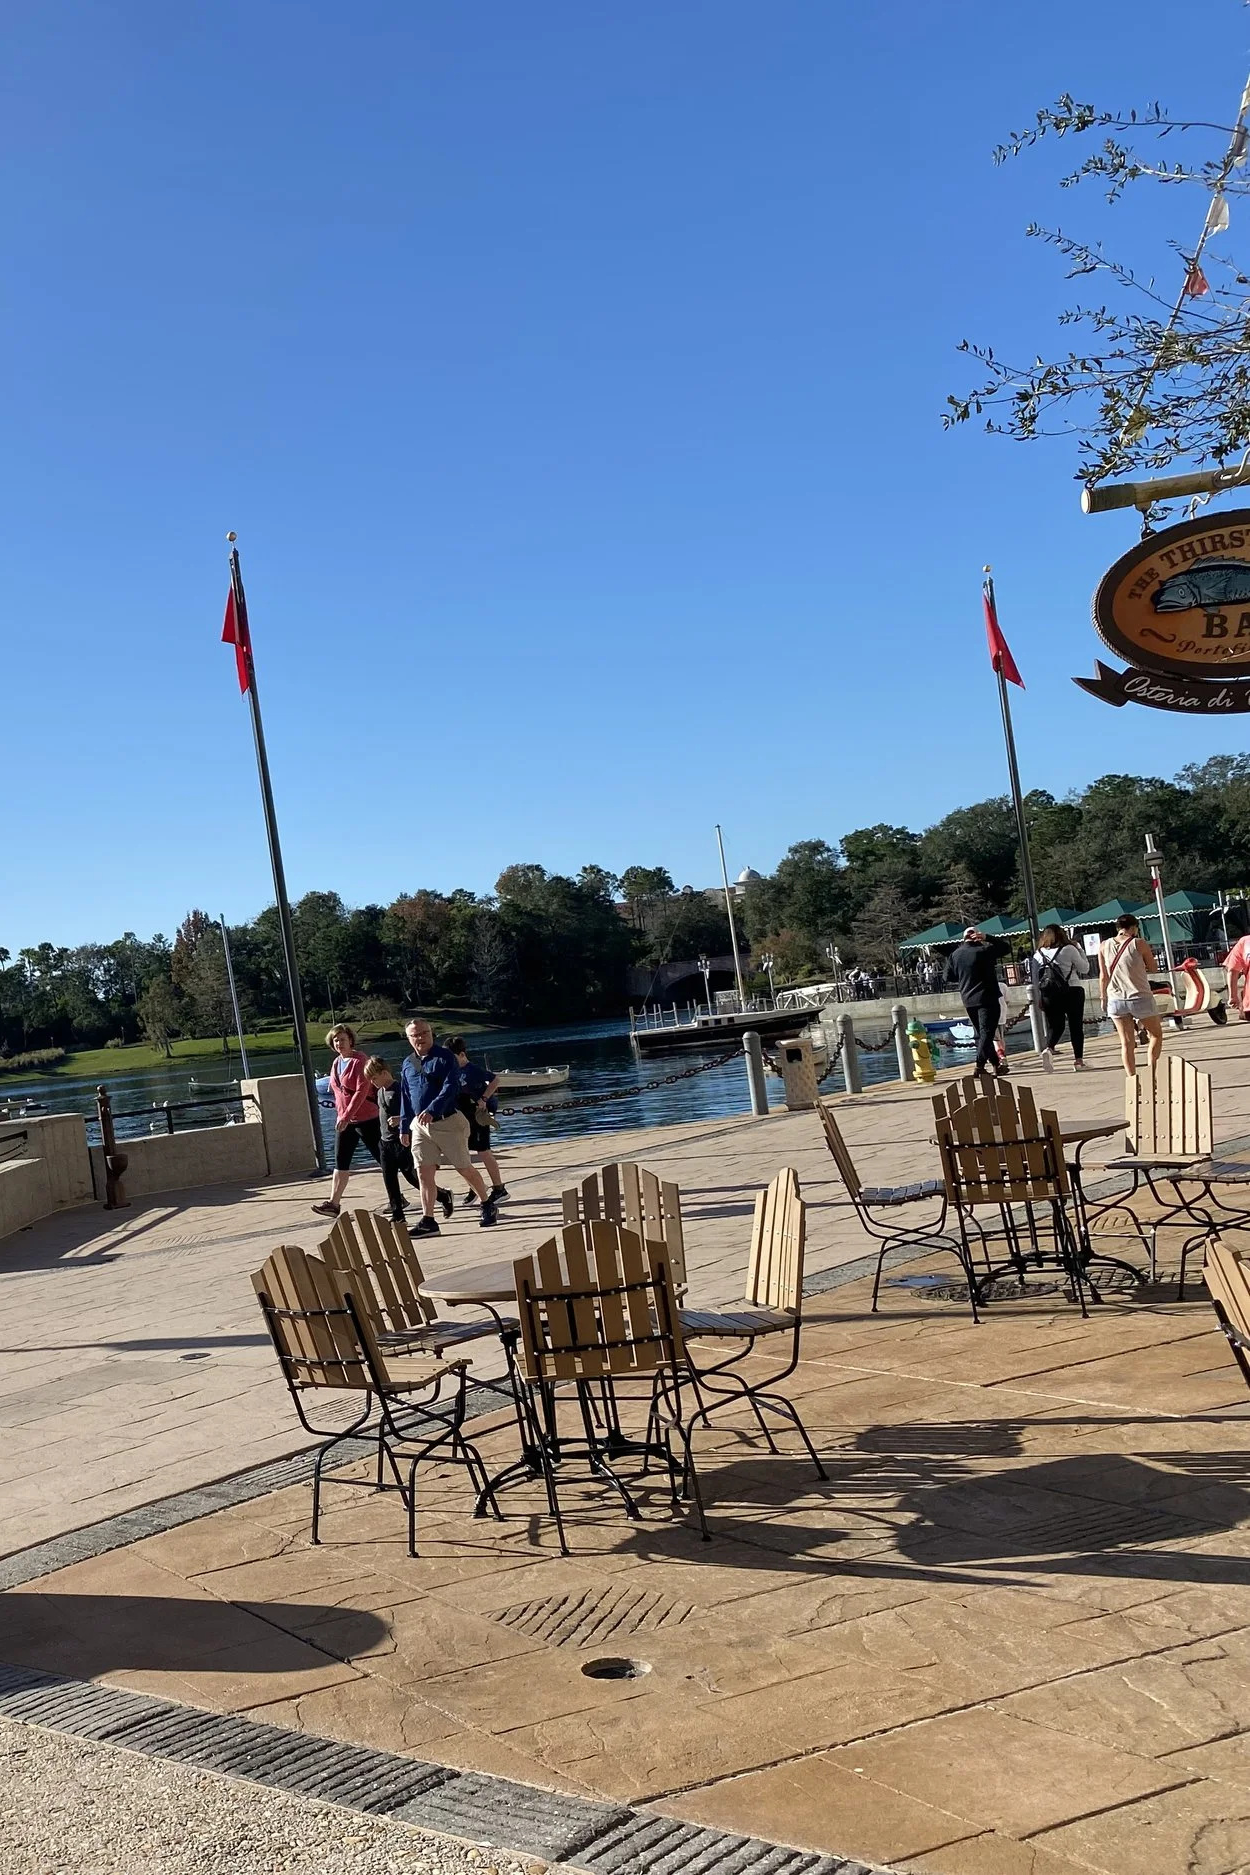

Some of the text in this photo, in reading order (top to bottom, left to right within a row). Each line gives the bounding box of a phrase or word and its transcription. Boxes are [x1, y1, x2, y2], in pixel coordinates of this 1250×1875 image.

[1128, 567, 1159, 599] THE
[1201, 611, 1250, 638] BA
[1124, 676, 1201, 707] Osteria
[1207, 688, 1235, 708] di
